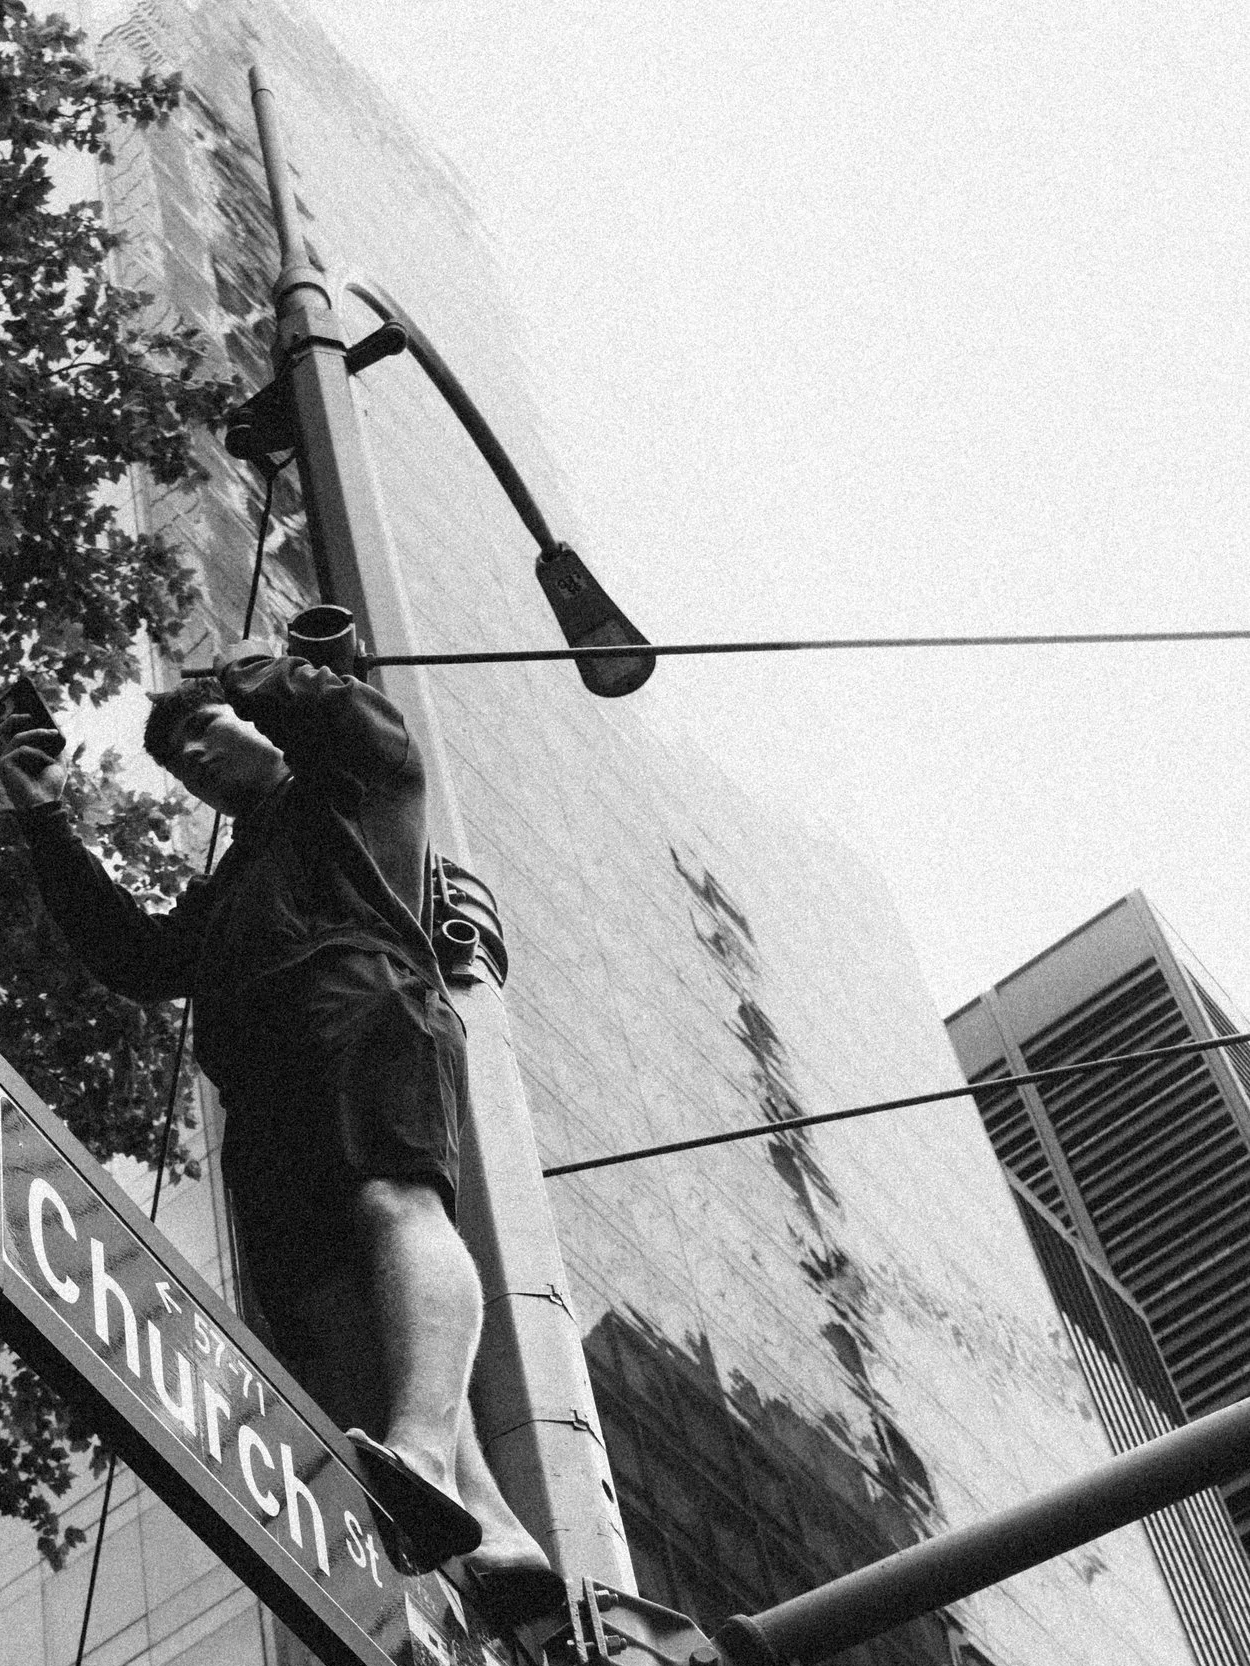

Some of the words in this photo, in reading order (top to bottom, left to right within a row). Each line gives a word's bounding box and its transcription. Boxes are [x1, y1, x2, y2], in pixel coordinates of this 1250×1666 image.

[28, 1178, 330, 1576] Church
[345, 1511, 383, 1588] St
[194, 1313, 267, 1416] 57-71
